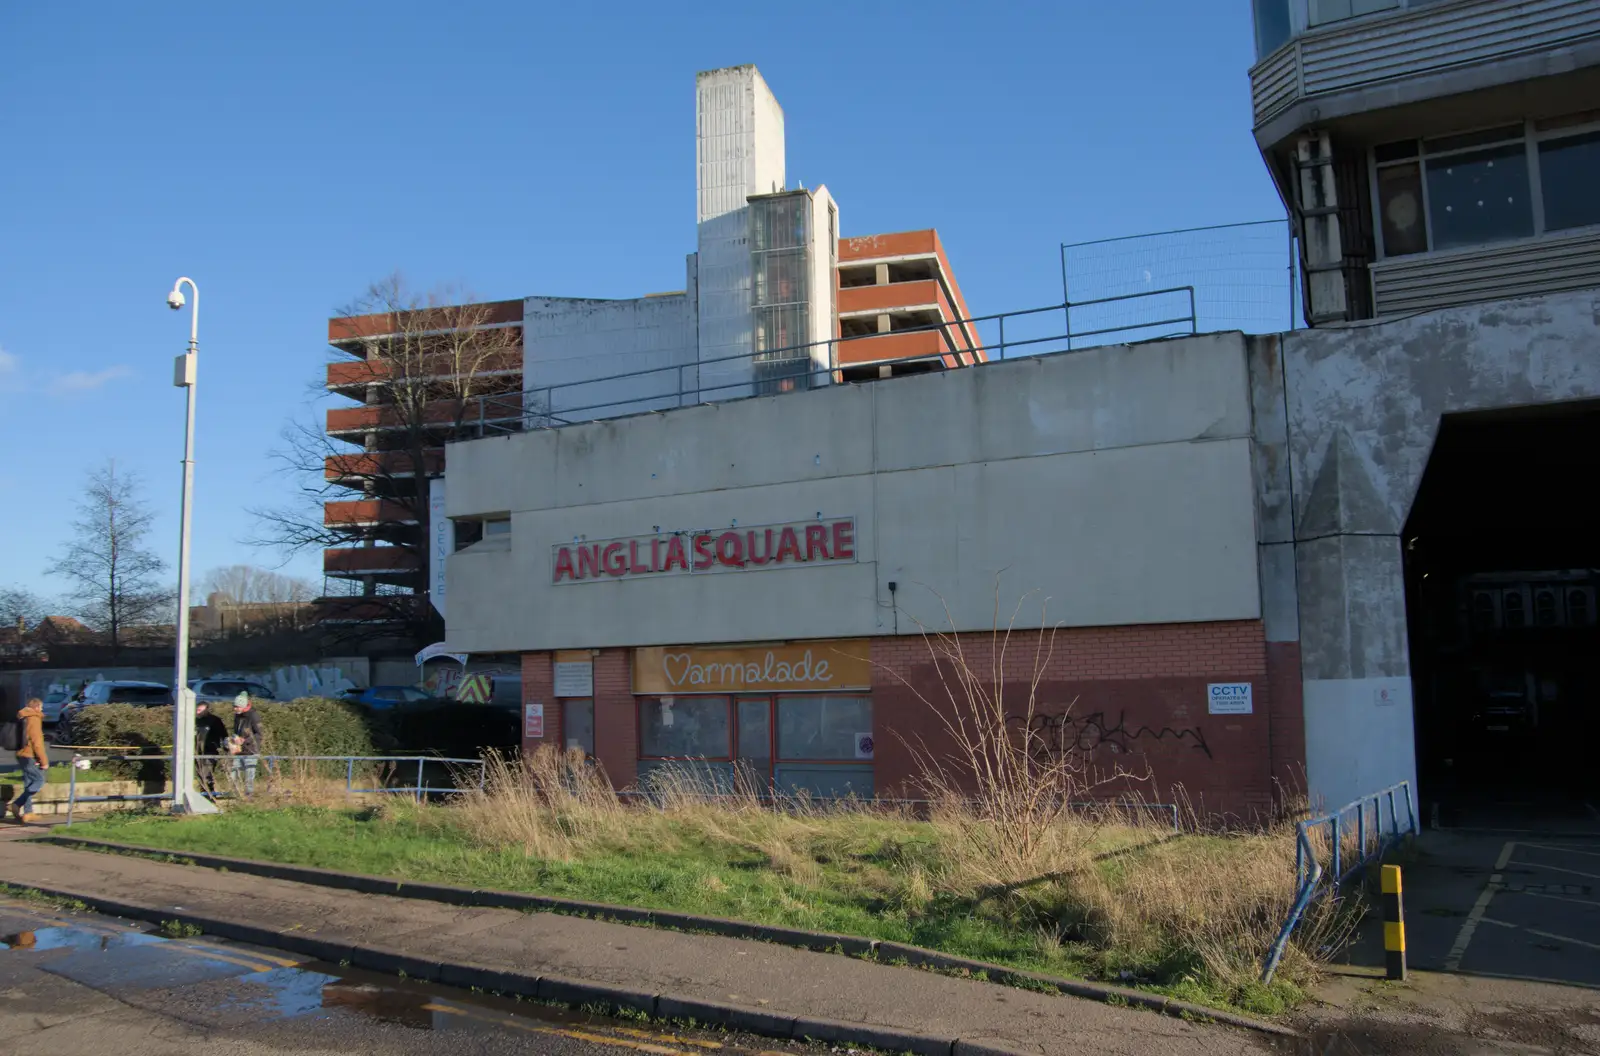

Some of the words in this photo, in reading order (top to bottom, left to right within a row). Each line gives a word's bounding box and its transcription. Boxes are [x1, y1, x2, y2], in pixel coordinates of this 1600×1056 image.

[437, 521, 446, 596] CENTRE
[553, 534, 688, 583] ANGLIA
[693, 521, 855, 569] SQUARE
[1212, 686, 1248, 696] CCTV
